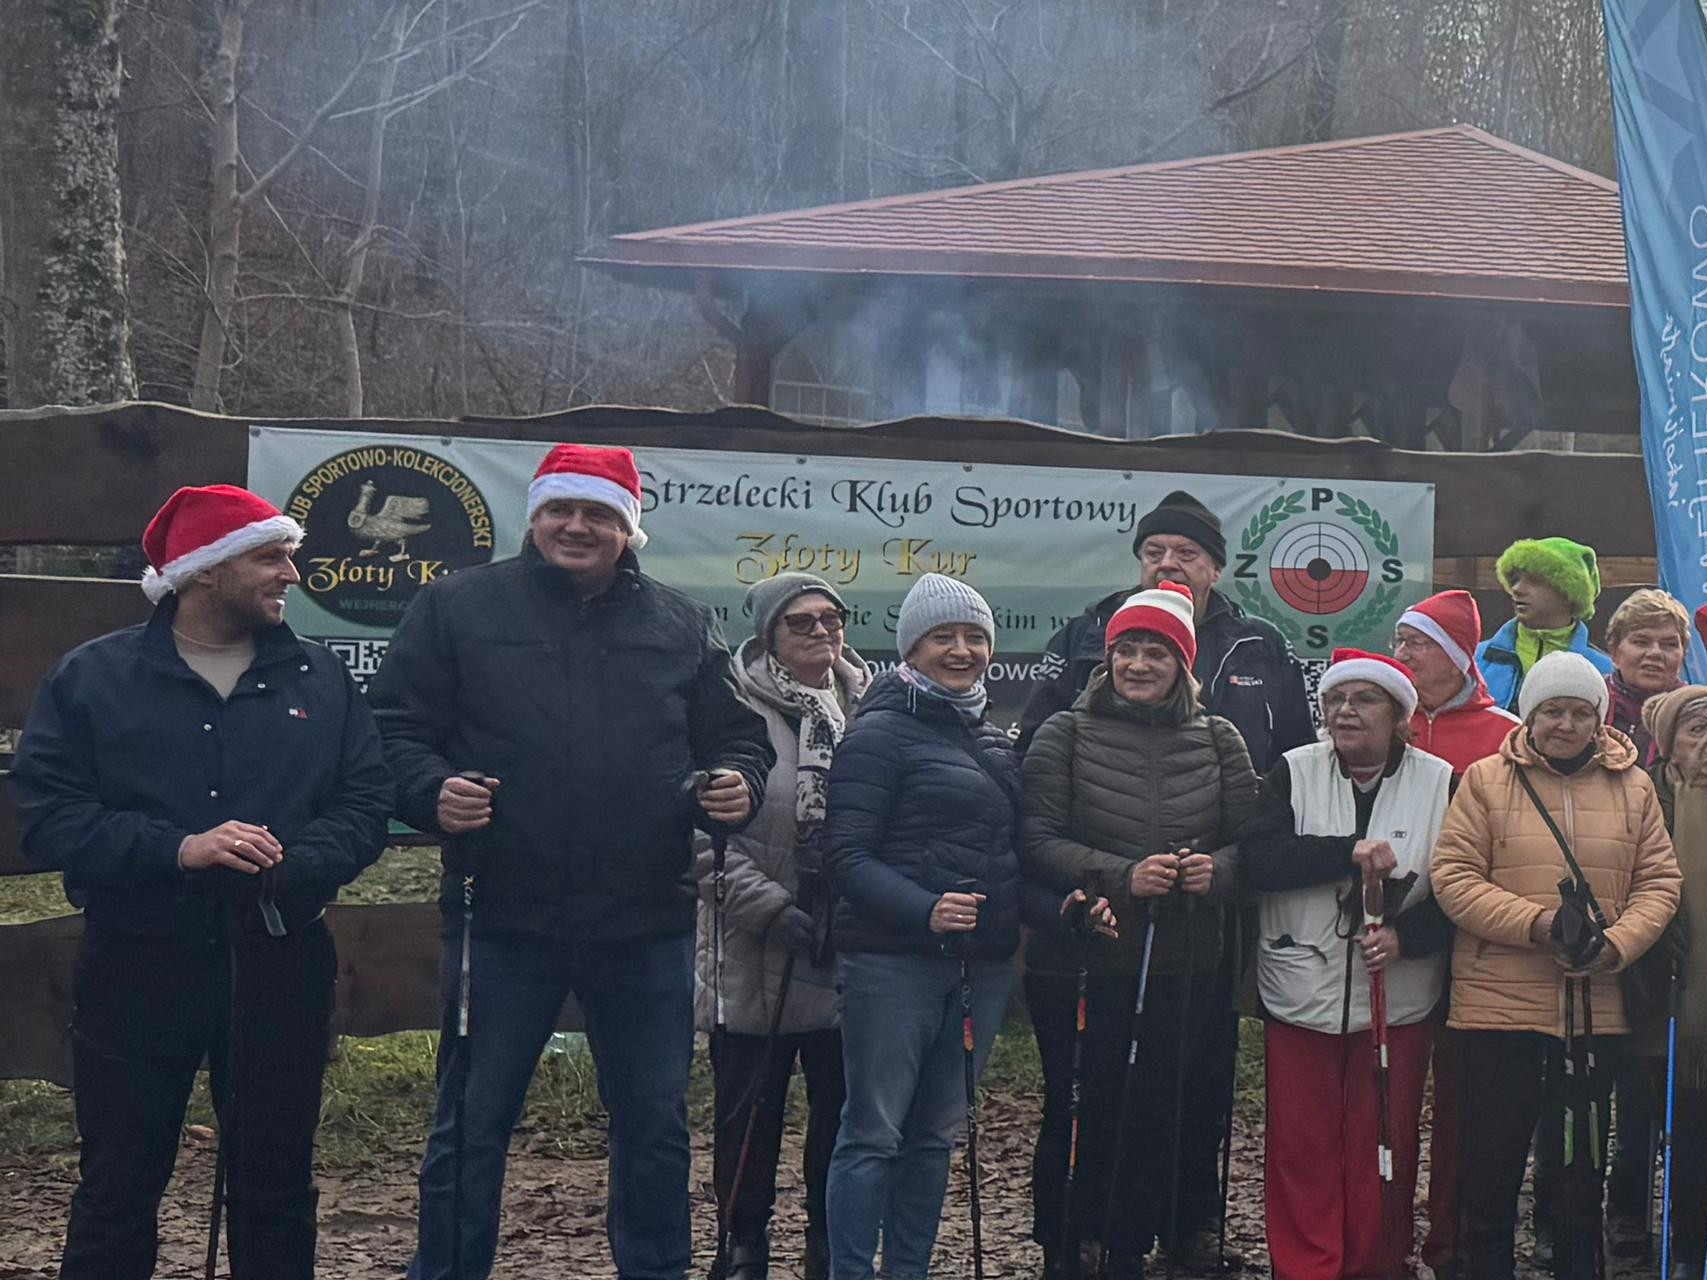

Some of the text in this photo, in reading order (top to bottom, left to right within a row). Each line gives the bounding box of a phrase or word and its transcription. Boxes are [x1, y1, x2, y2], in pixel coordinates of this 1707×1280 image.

[831, 480, 932, 528] Klub
[951, 486, 1136, 533] Sportowy
[1311, 487, 1334, 511] P
[882, 538, 977, 576] Kur
[1234, 554, 1258, 578] Z
[1381, 558, 1403, 583] S
[1306, 624, 1329, 649] S
